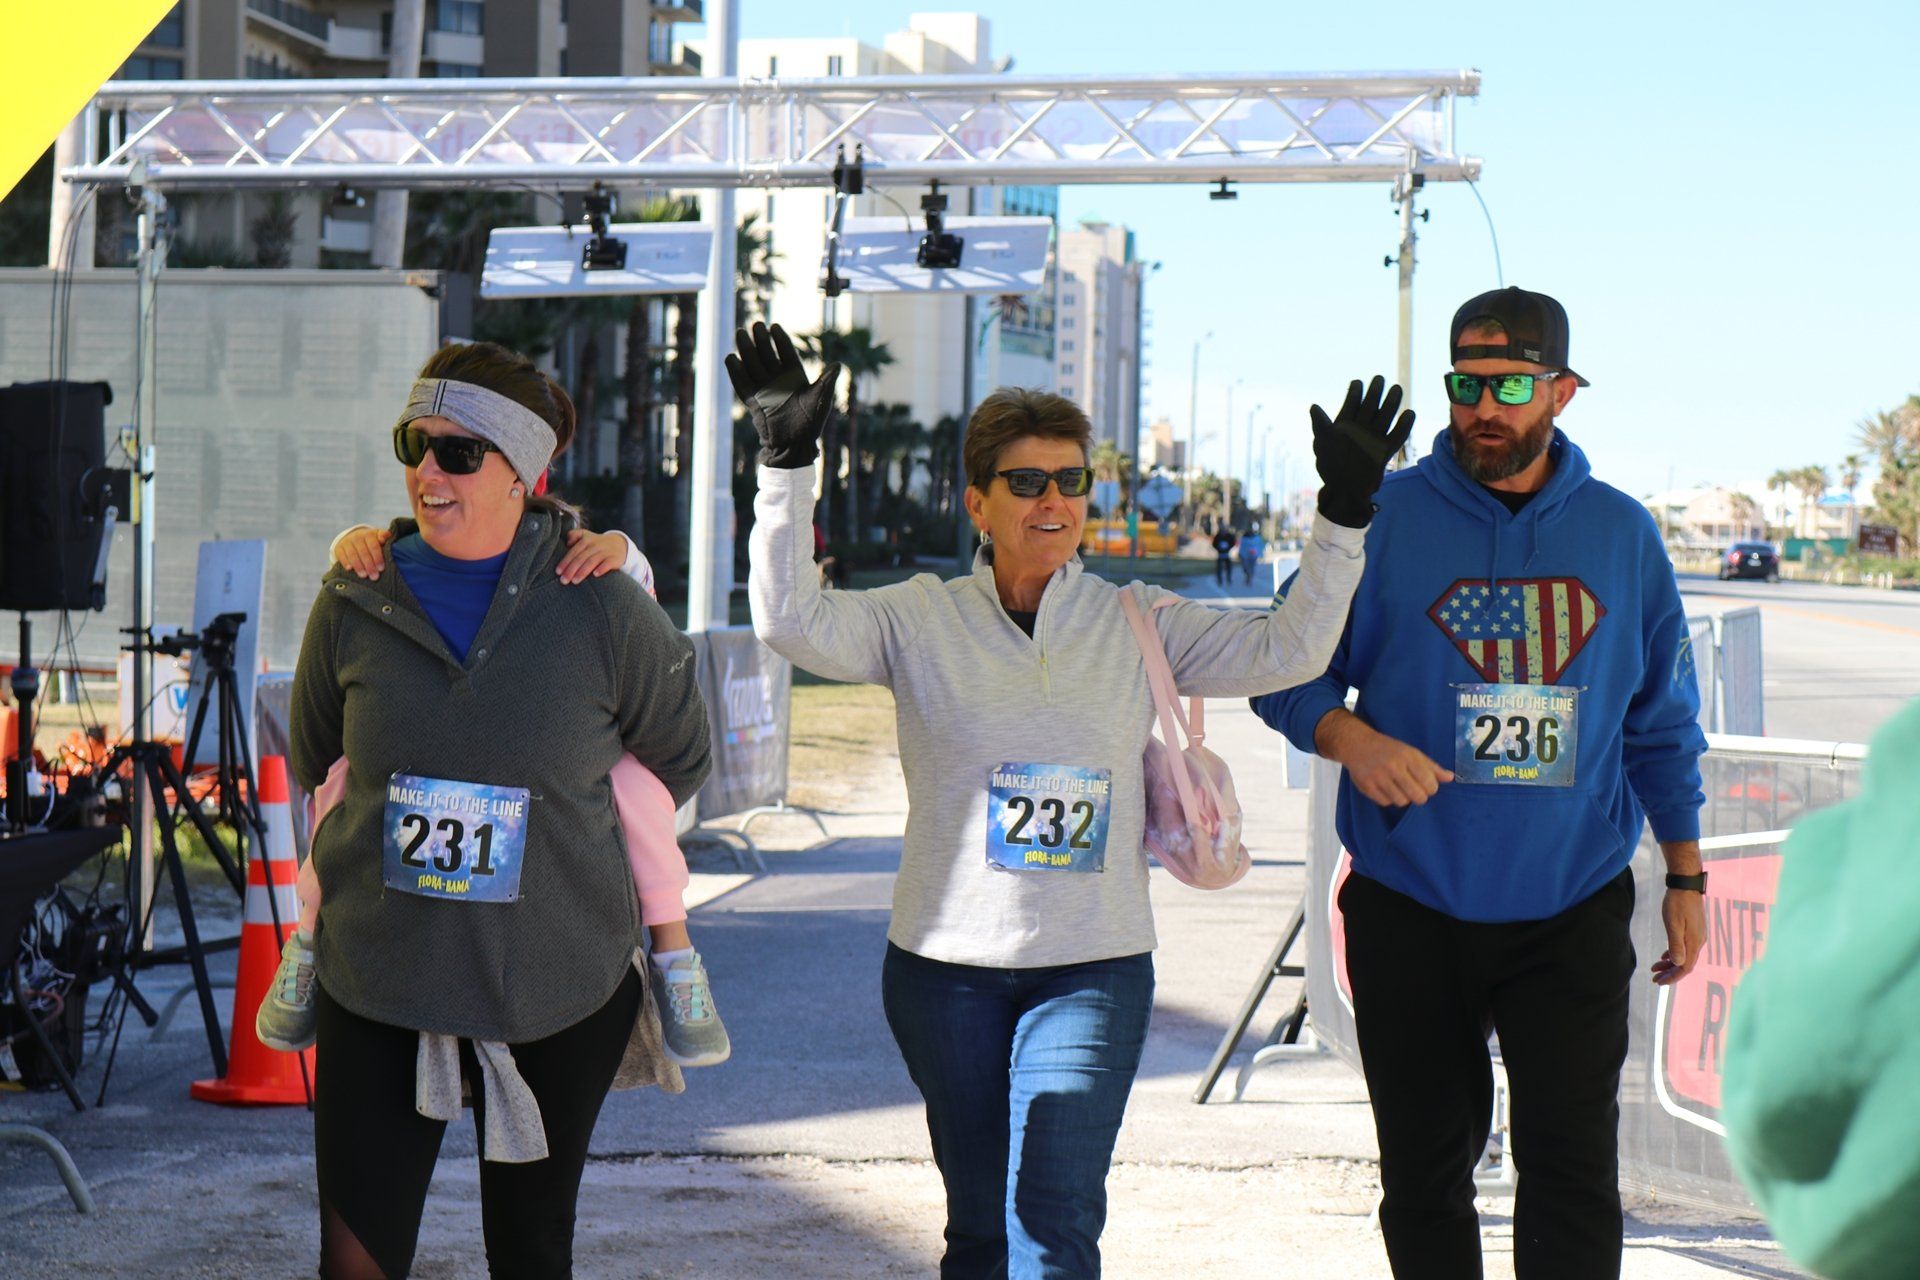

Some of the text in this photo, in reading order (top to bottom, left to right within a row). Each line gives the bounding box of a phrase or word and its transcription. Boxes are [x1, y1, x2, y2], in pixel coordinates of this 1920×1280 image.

[1461, 694, 1573, 712] MAKE IT TO THE LINE
[1475, 715, 1558, 763] 236
[390, 786, 523, 817] MAKE IT TO THE LINE
[993, 774, 1109, 794] MAKE IT TO THE LINE
[1006, 796, 1094, 848] 232
[401, 814, 495, 875] 231
